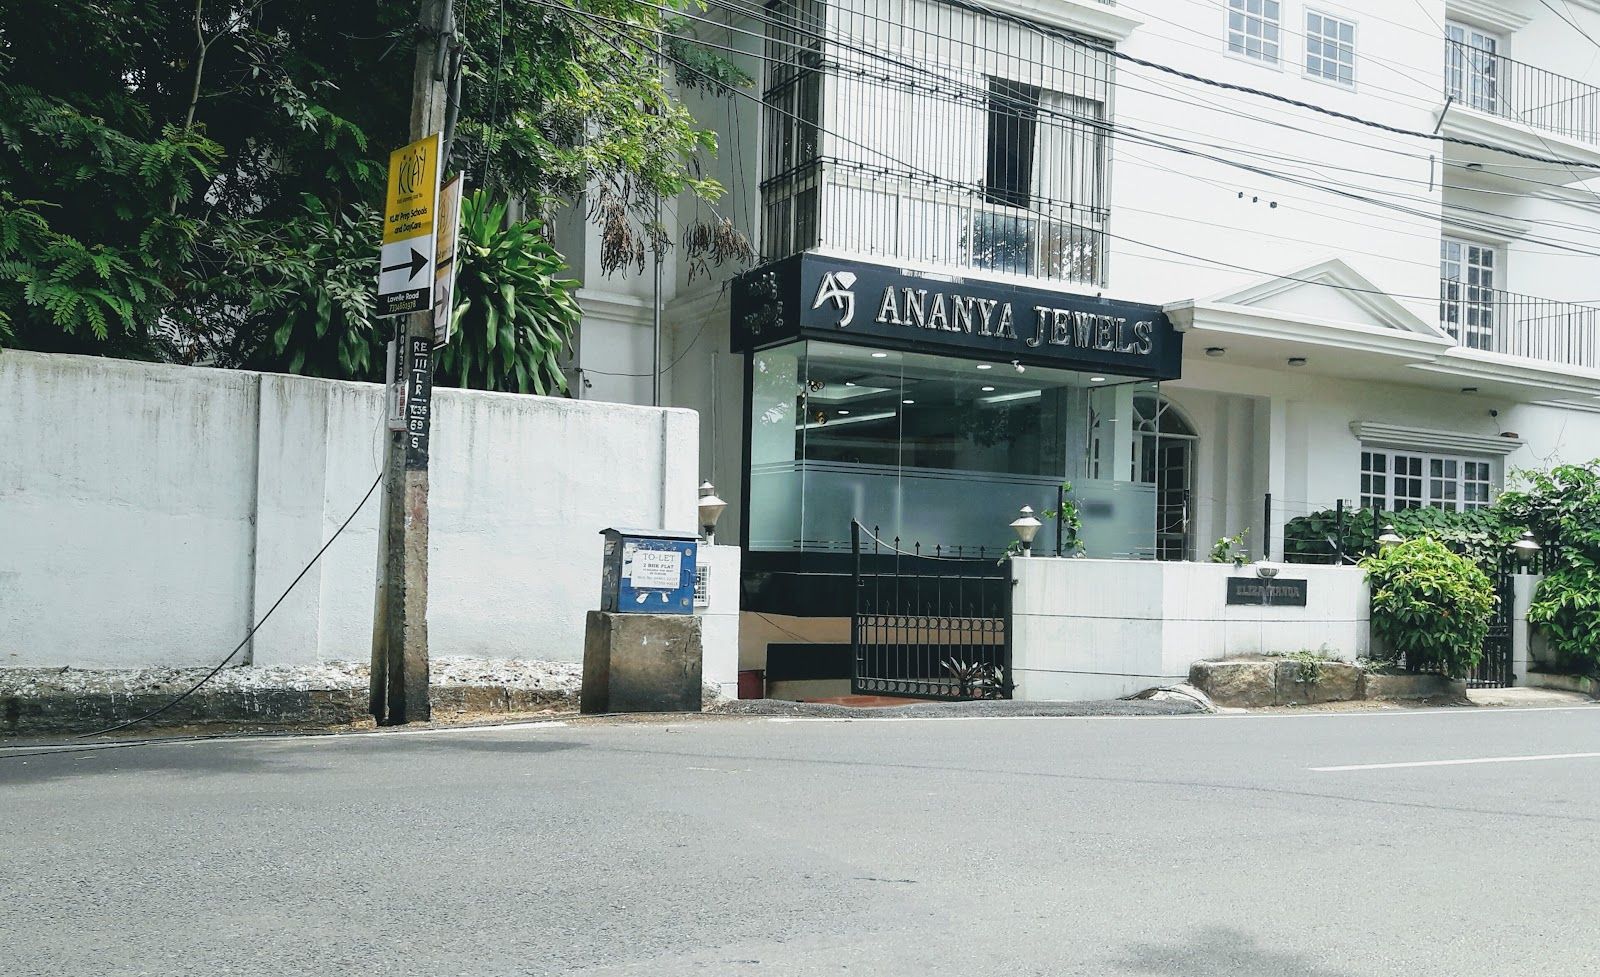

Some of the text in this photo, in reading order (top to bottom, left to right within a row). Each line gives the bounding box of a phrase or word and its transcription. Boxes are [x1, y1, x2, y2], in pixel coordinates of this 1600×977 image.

[411, 206, 427, 217] Schools
[405, 290, 420, 300] Road
[876, 285, 1153, 355] ANANYA JEWELS
[413, 341, 428, 352] RE
[410, 419, 424, 431] 69
[411, 437, 419, 449] S
